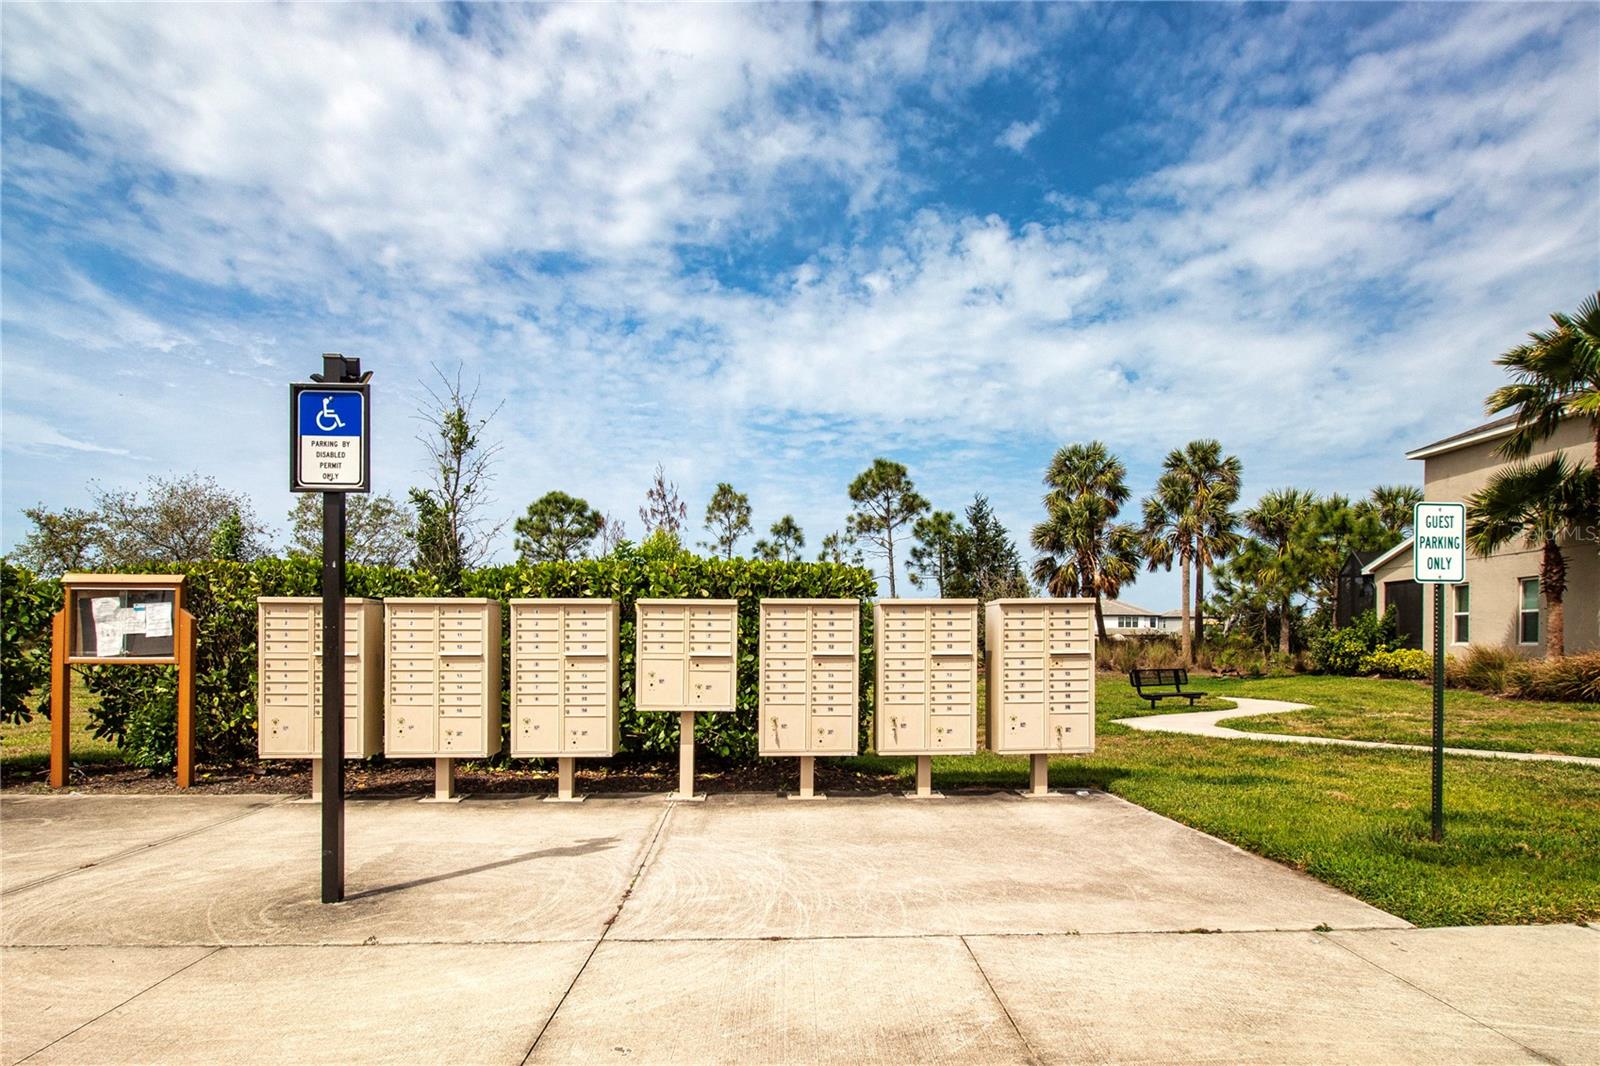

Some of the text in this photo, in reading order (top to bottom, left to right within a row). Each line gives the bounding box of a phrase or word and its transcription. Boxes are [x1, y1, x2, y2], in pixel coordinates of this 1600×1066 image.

[1425, 515, 1454, 528] GUEST
[1419, 536, 1460, 549] PARKING
[1427, 557, 1452, 570] ONLY
